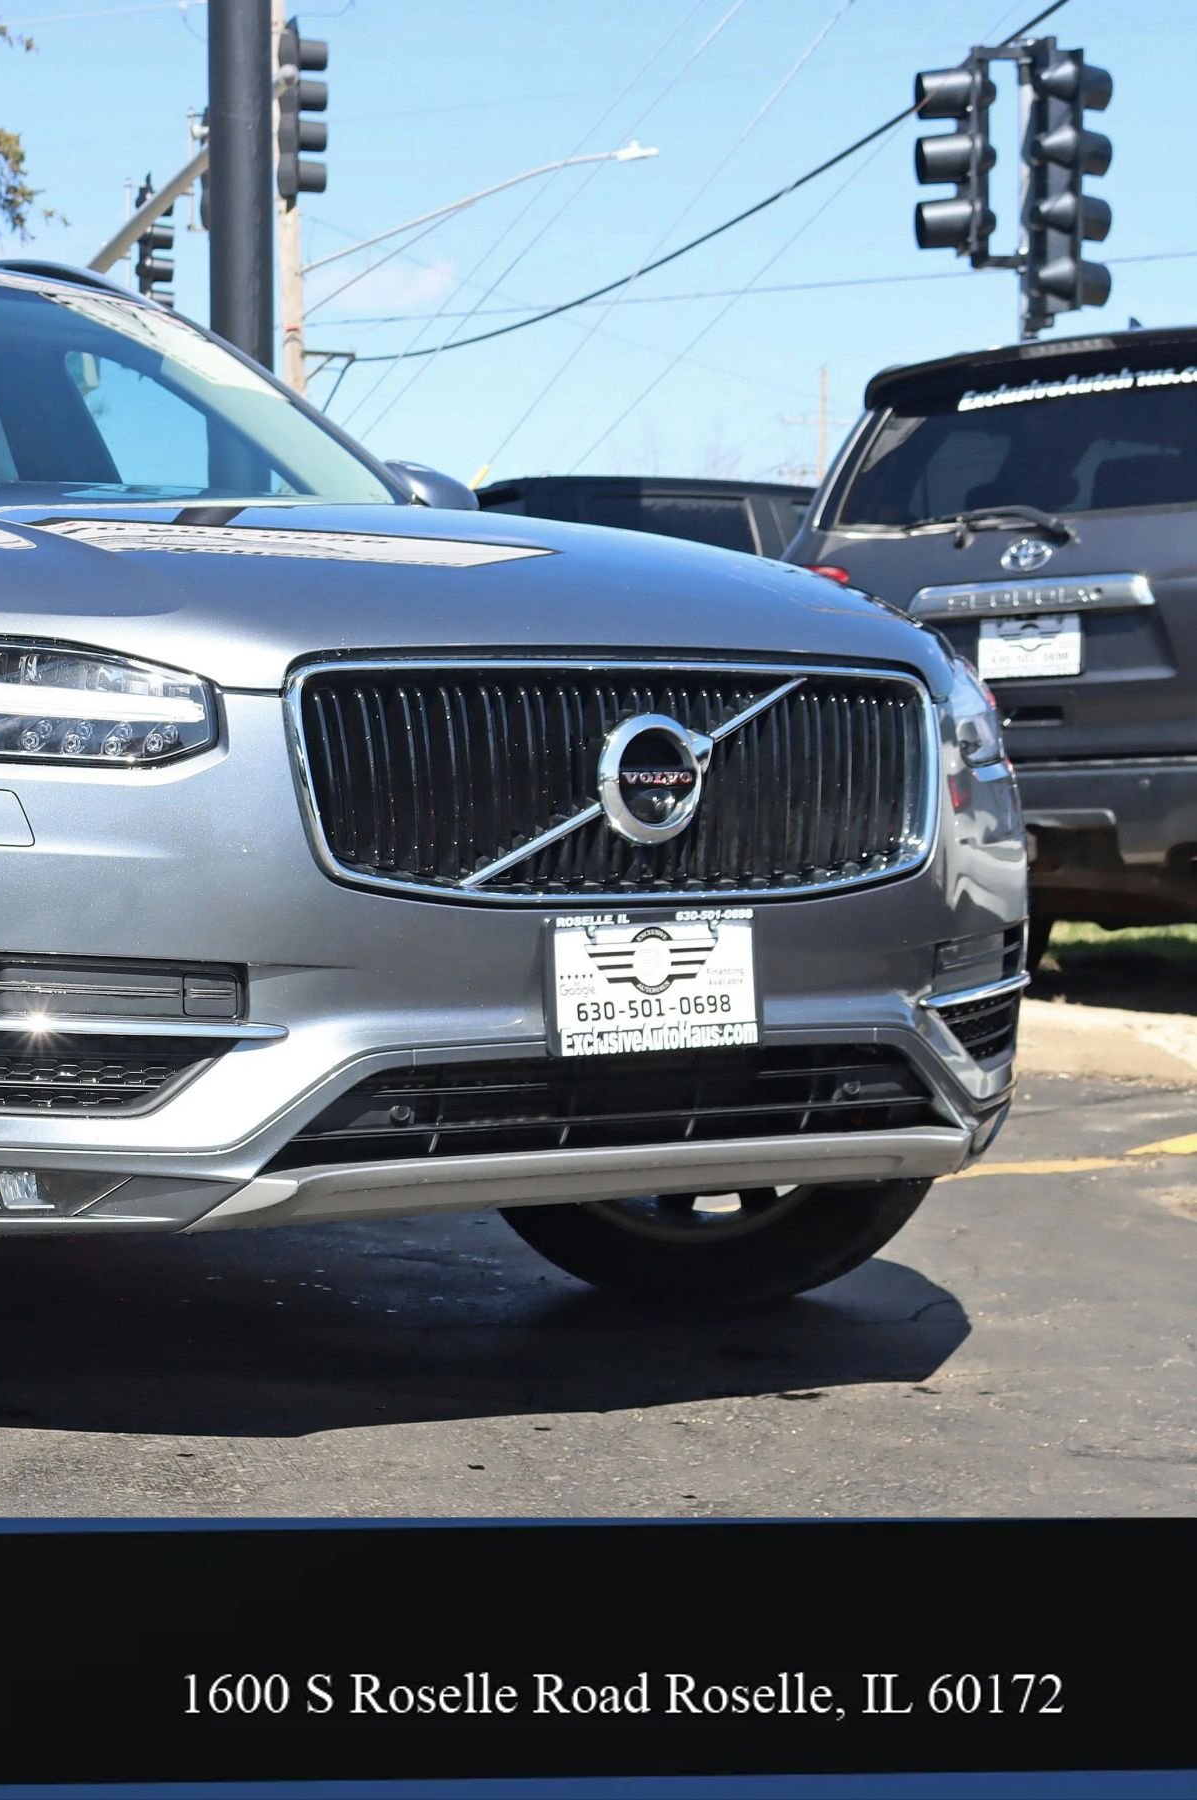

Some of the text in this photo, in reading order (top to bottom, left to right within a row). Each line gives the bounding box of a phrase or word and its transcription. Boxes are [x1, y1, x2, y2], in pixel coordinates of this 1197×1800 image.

[622, 771, 692, 785] VOLVO
[617, 914, 630, 924] IL
[559, 983, 596, 998] Google
[577, 995, 731, 1022] 630-501-0698
[561, 1021, 758, 1056] ExclusiveAutoHaus.com
